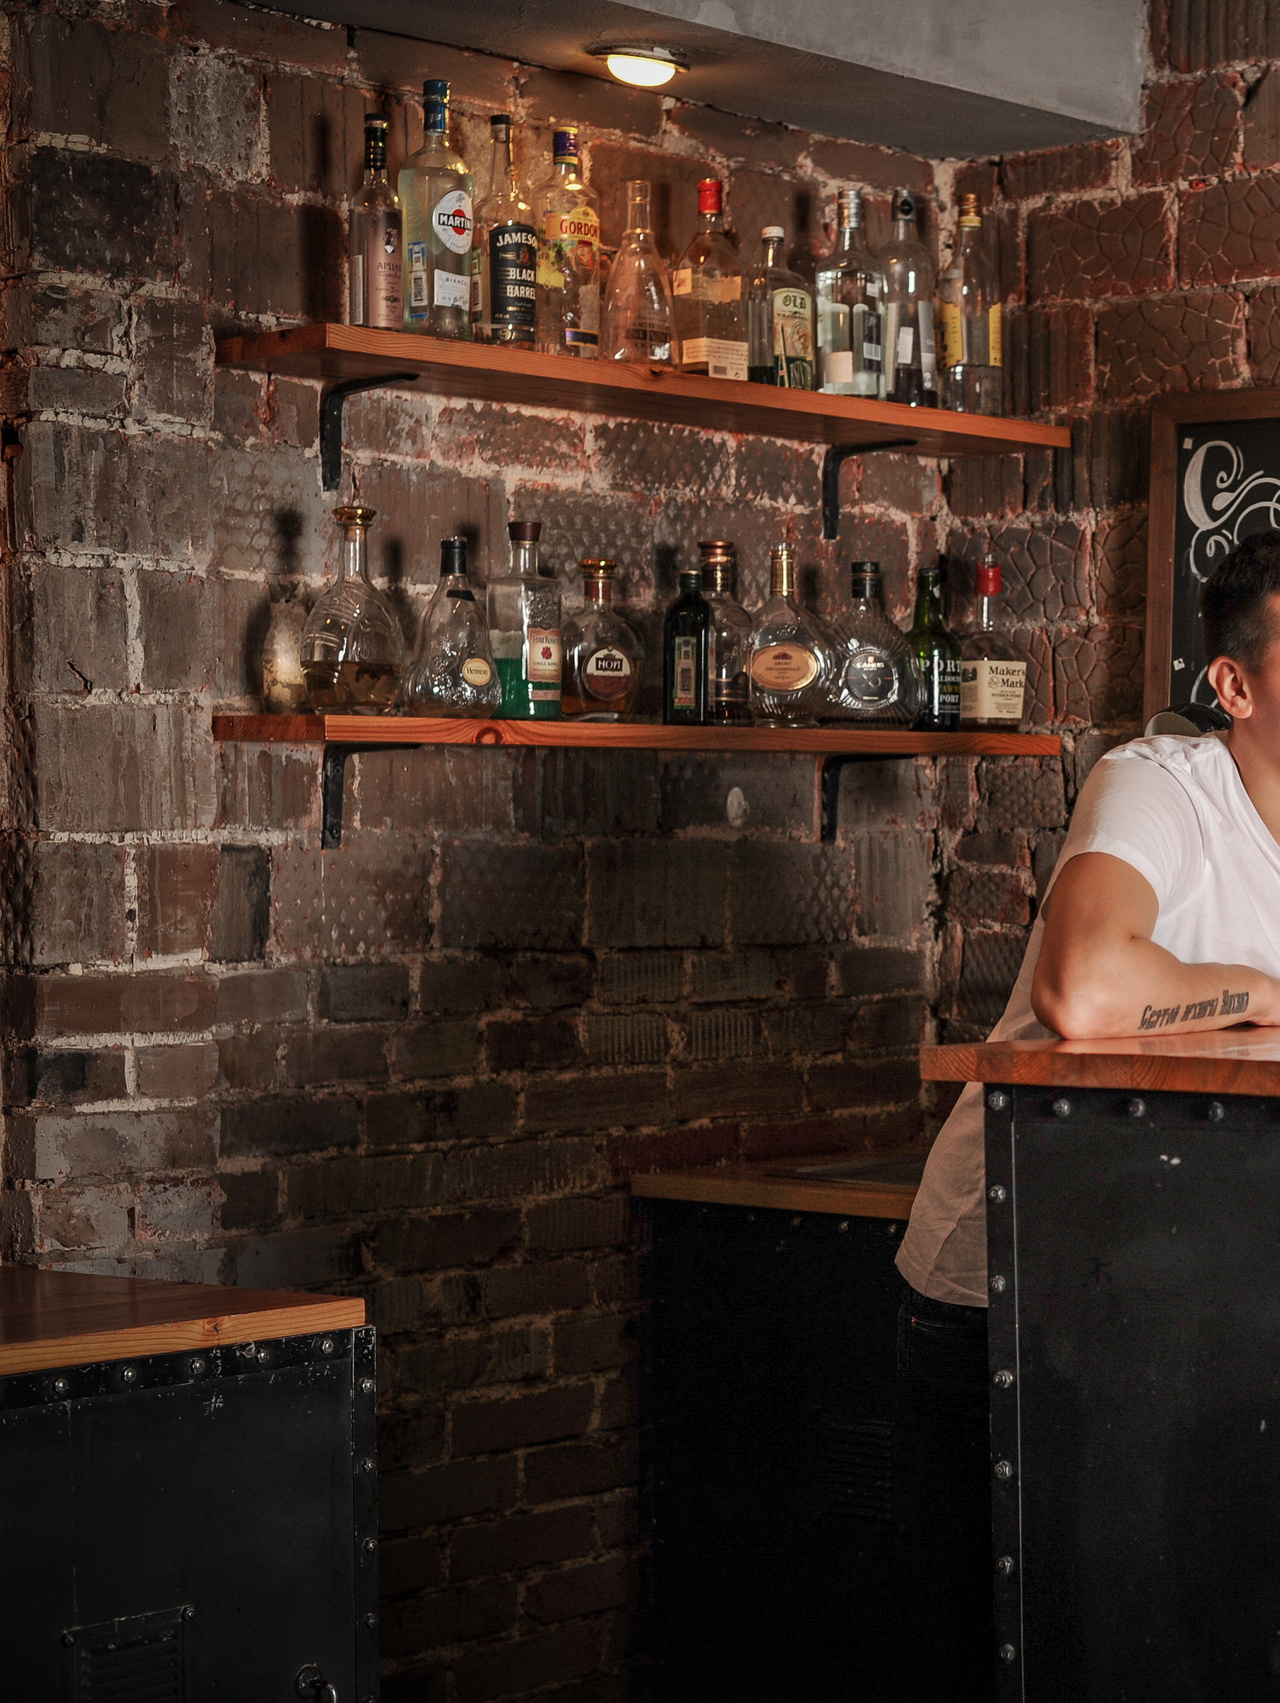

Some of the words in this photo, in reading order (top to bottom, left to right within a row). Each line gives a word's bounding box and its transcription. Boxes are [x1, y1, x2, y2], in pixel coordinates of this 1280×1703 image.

[508, 267, 535, 282] BLACK
[507, 285, 537, 300] BARREL
[782, 295, 806, 309] OLD
[1000, 678, 1024, 689] Mark
